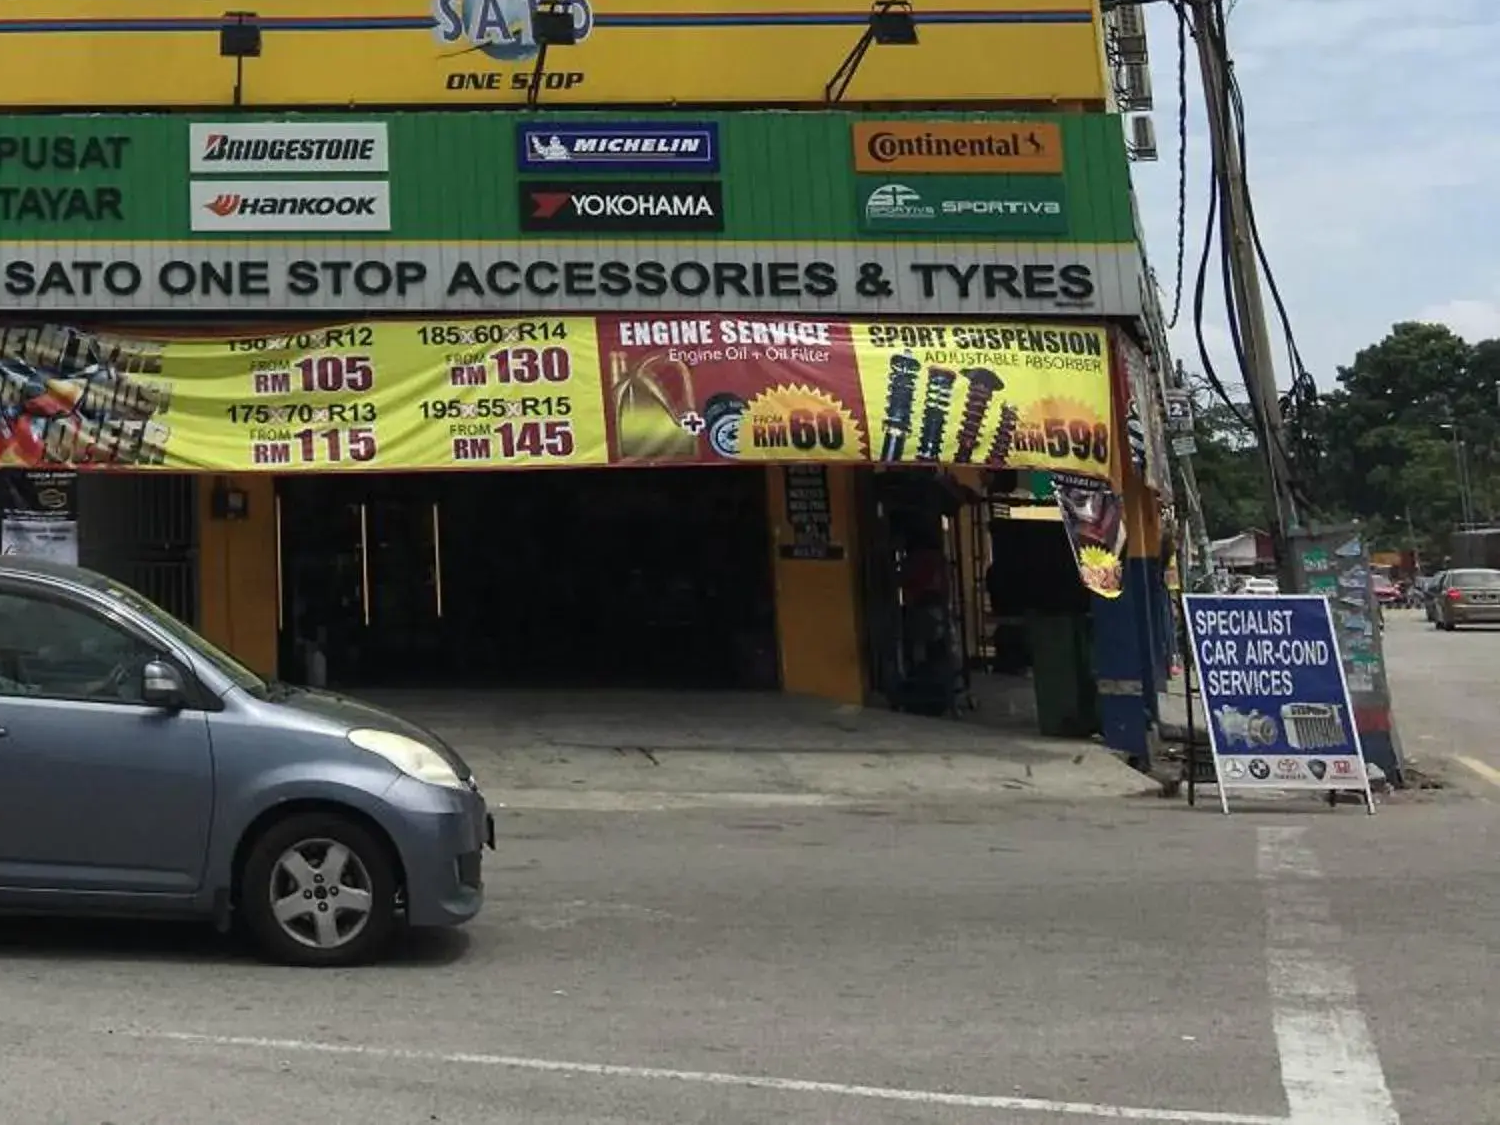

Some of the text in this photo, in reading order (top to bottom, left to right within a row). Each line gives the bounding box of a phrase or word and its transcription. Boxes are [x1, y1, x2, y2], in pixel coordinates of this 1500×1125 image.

[446, 72, 585, 90] ONE STOP
[202, 134, 375, 162] BRIDGESTONE
[573, 137, 700, 153] MICHELIN
[868, 132, 1020, 163] Continental
[571, 194, 714, 218] YOKOHAMA
[4, 260, 1095, 300] SATO ONE STOP ACCESSORIES & TYRES
[619, 320, 832, 346] ENGINE SERVICE
[868, 325, 1101, 356] SPORT SUSPENSION
[668, 348, 723, 365] Engine
[725, 347, 747, 361] Oil
[765, 348, 788, 362] Oil
[791, 348, 830, 363] Filter
[924, 349, 1103, 372] ADJUSTABLE ABSORBER
[450, 424, 491, 436] FROM
[1195, 610, 1293, 636] SPECIALIST
[1200, 640, 1329, 666] CAR AIR-COND
[1208, 670, 1293, 696] SERVICES
